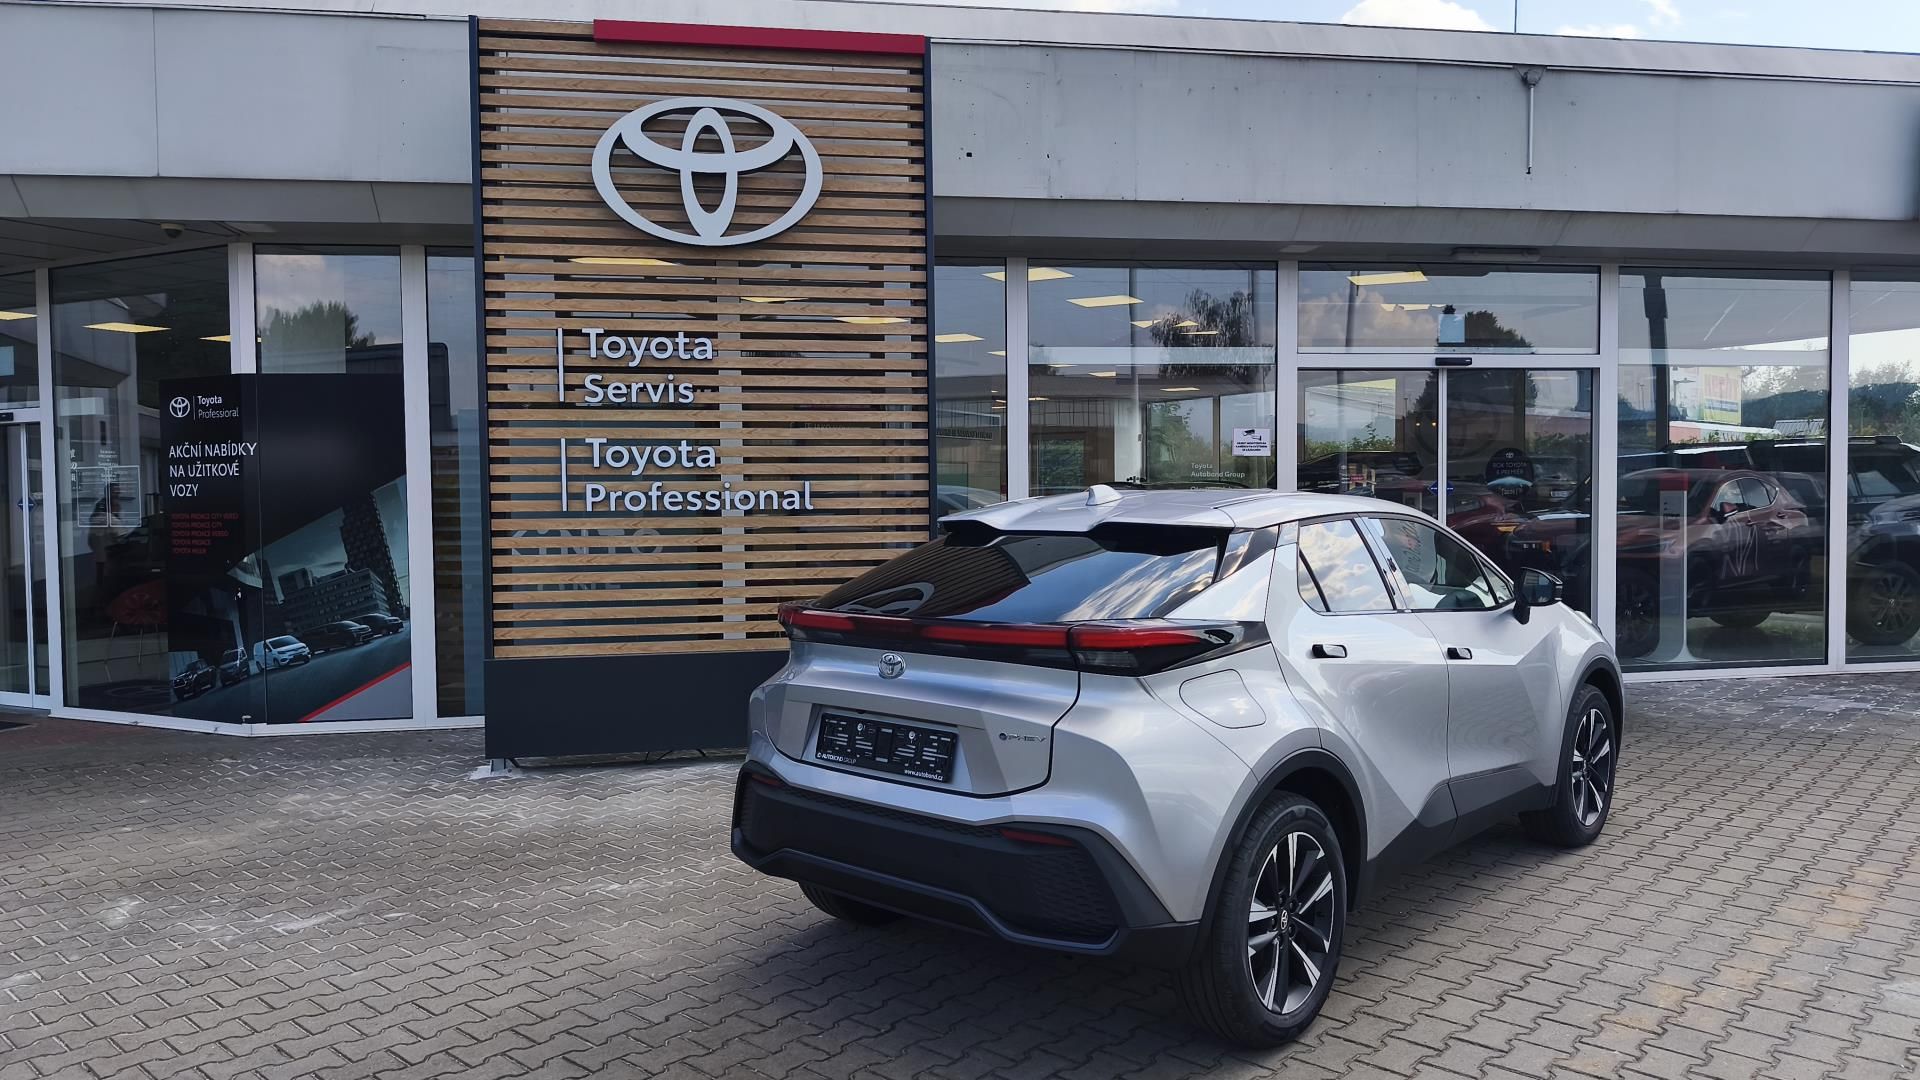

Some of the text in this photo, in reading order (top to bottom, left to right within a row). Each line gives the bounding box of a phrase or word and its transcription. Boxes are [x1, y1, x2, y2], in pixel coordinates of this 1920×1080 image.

[582, 327, 714, 367] Toyota
[584, 373, 695, 404] Servis
[197, 395, 223, 407] Toyota
[198, 408, 239, 419] Professional
[169, 440, 257, 458] AKČNÍ NABÍDKY
[585, 437, 716, 476] Toyota
[170, 460, 240, 477] NA UŽITKOVÉ
[169, 483, 199, 497] VOZY
[585, 480, 814, 512] Professional
